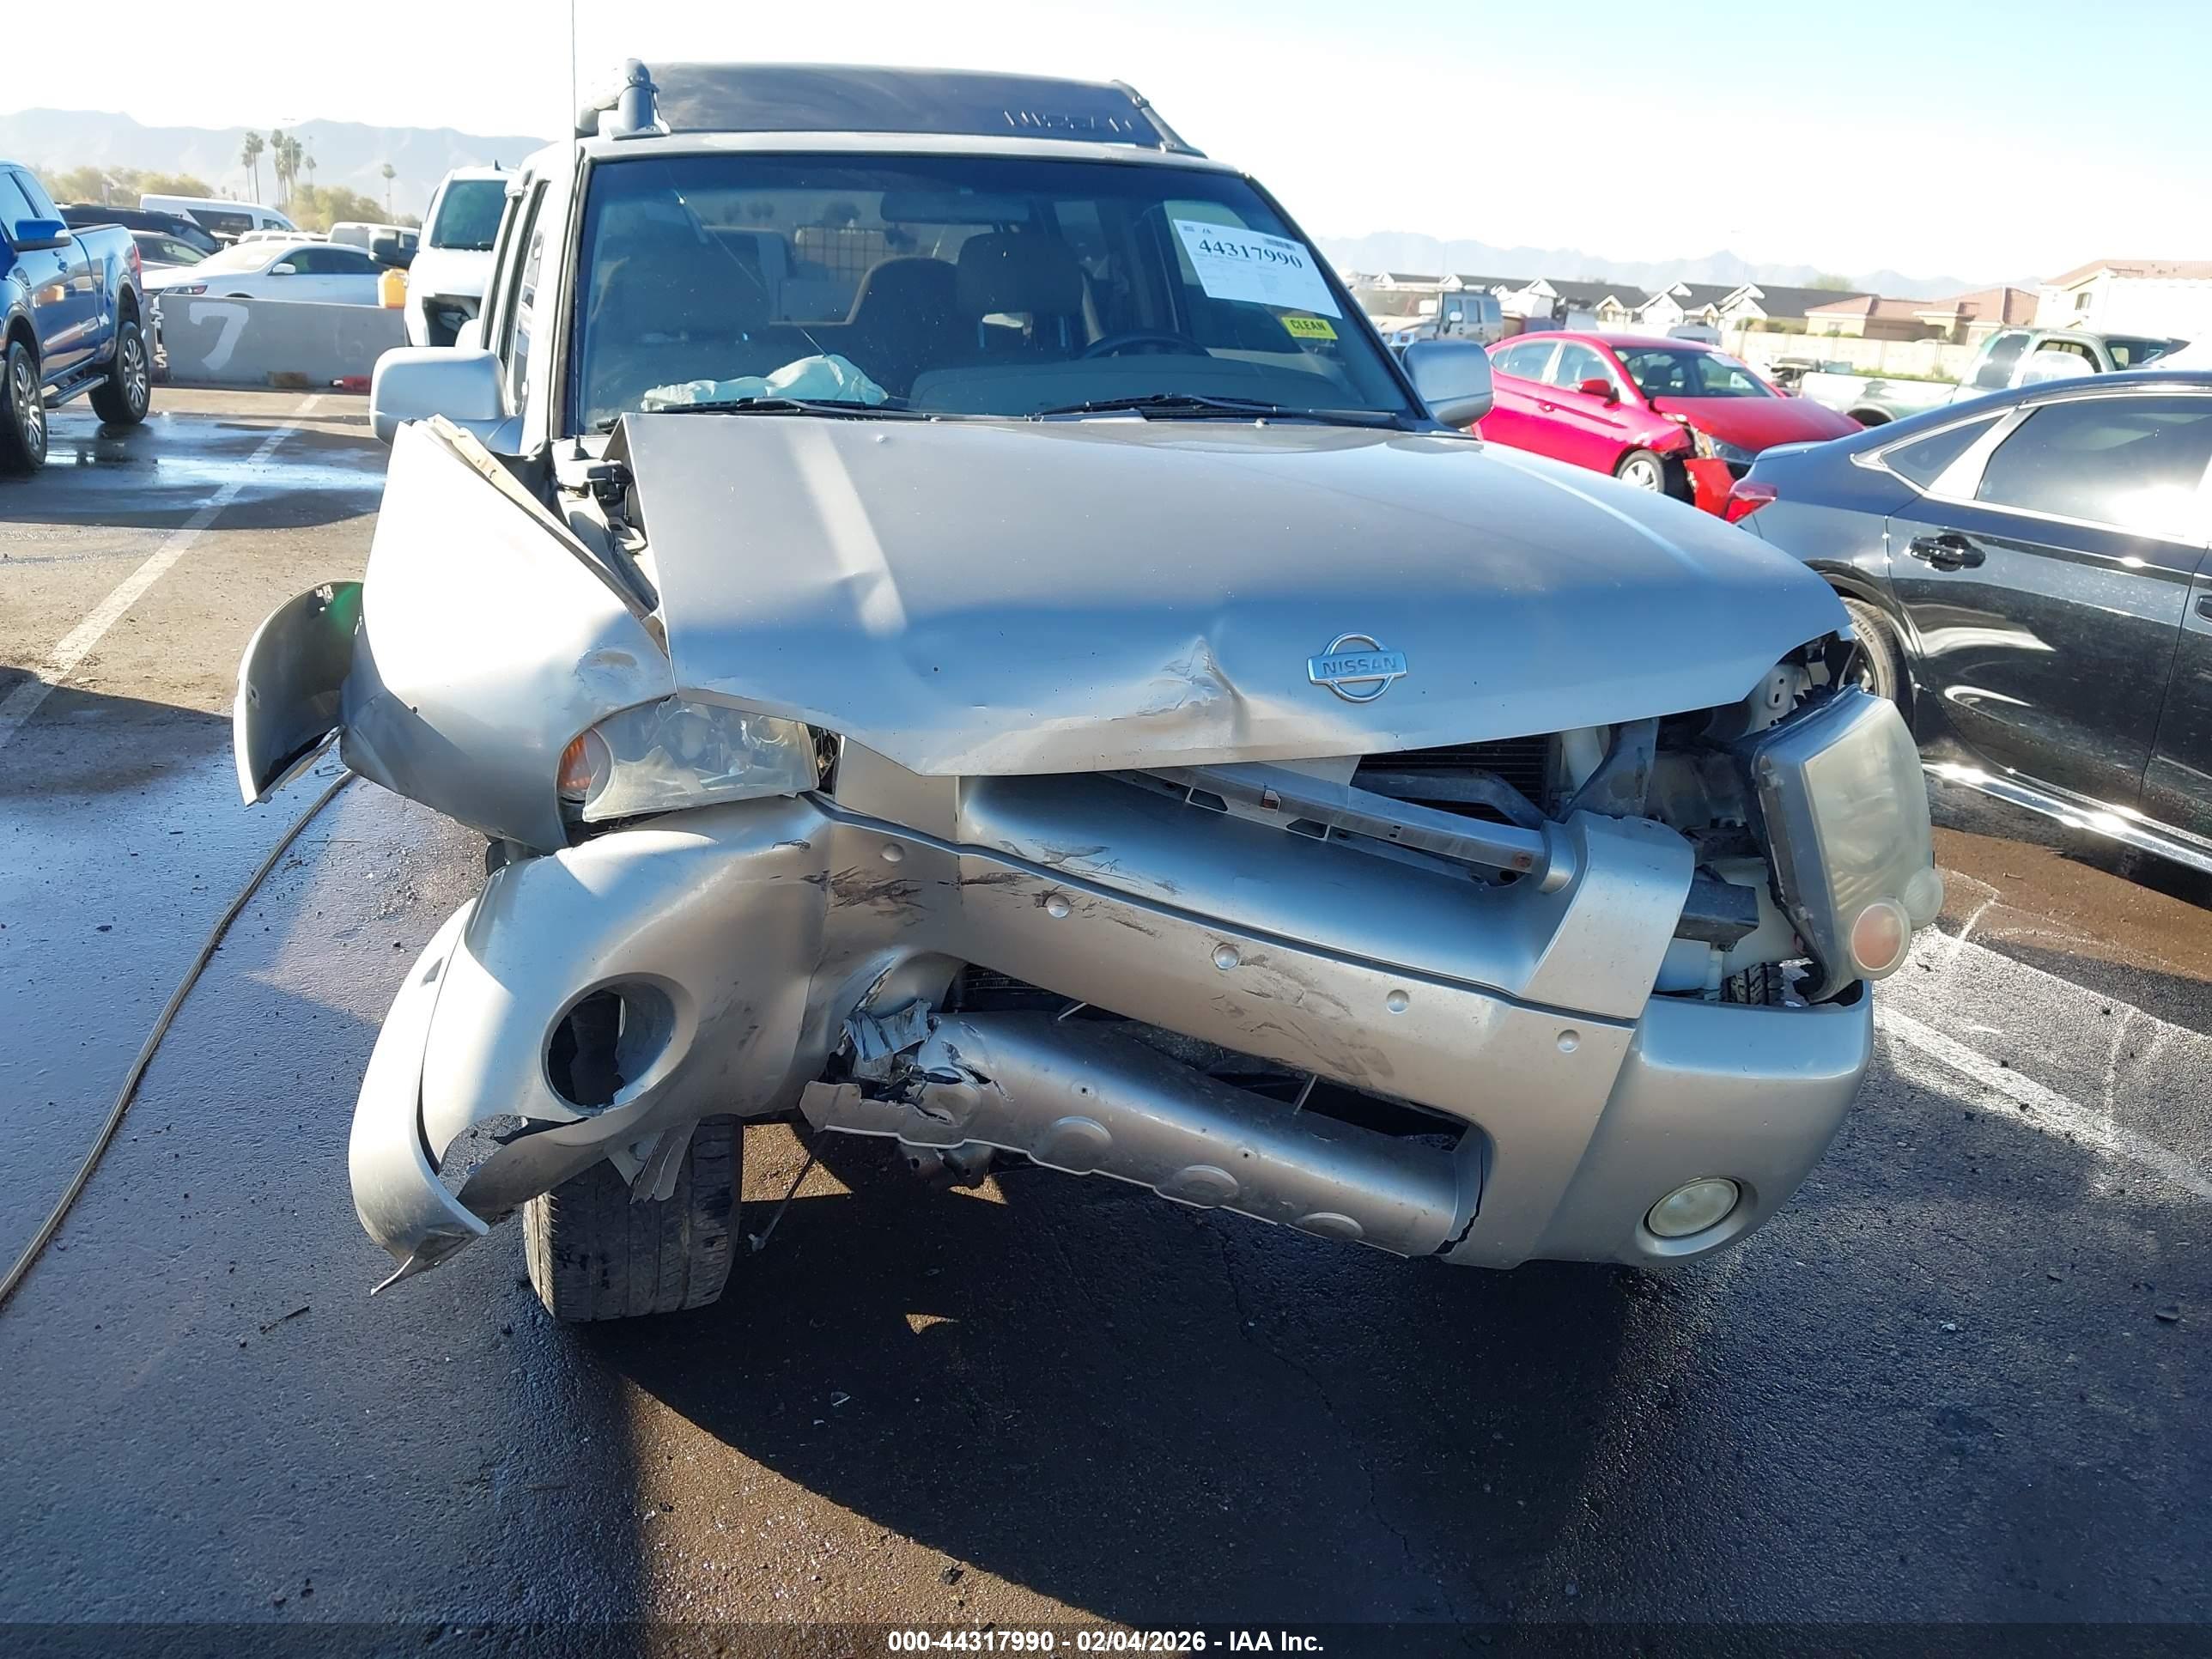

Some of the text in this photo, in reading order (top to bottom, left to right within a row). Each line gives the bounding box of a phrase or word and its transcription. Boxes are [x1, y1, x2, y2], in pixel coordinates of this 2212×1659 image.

[1200, 239, 1304, 269] 44317990
[189, 301, 249, 370] 7
[1291, 319, 1327, 331] CLEAN
[1322, 657, 1396, 674] NISSAN
